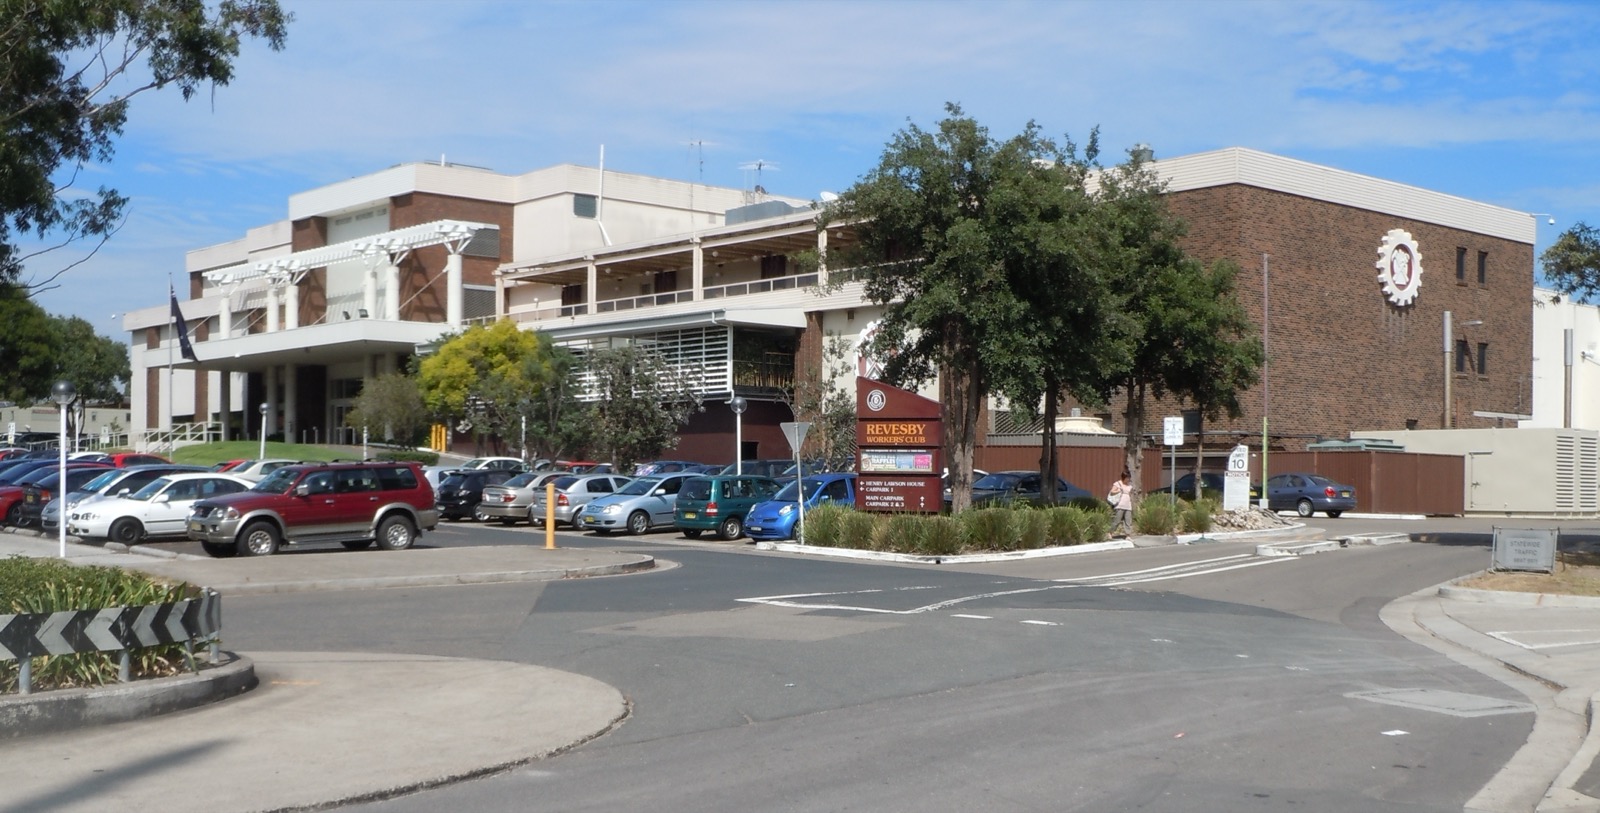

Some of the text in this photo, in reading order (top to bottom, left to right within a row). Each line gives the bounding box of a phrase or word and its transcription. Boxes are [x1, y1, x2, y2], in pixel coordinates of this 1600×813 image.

[866, 424, 926, 435] REVESBY
[1231, 459, 1245, 469] 10
[1509, 540, 1541, 548] STATEWIDE
